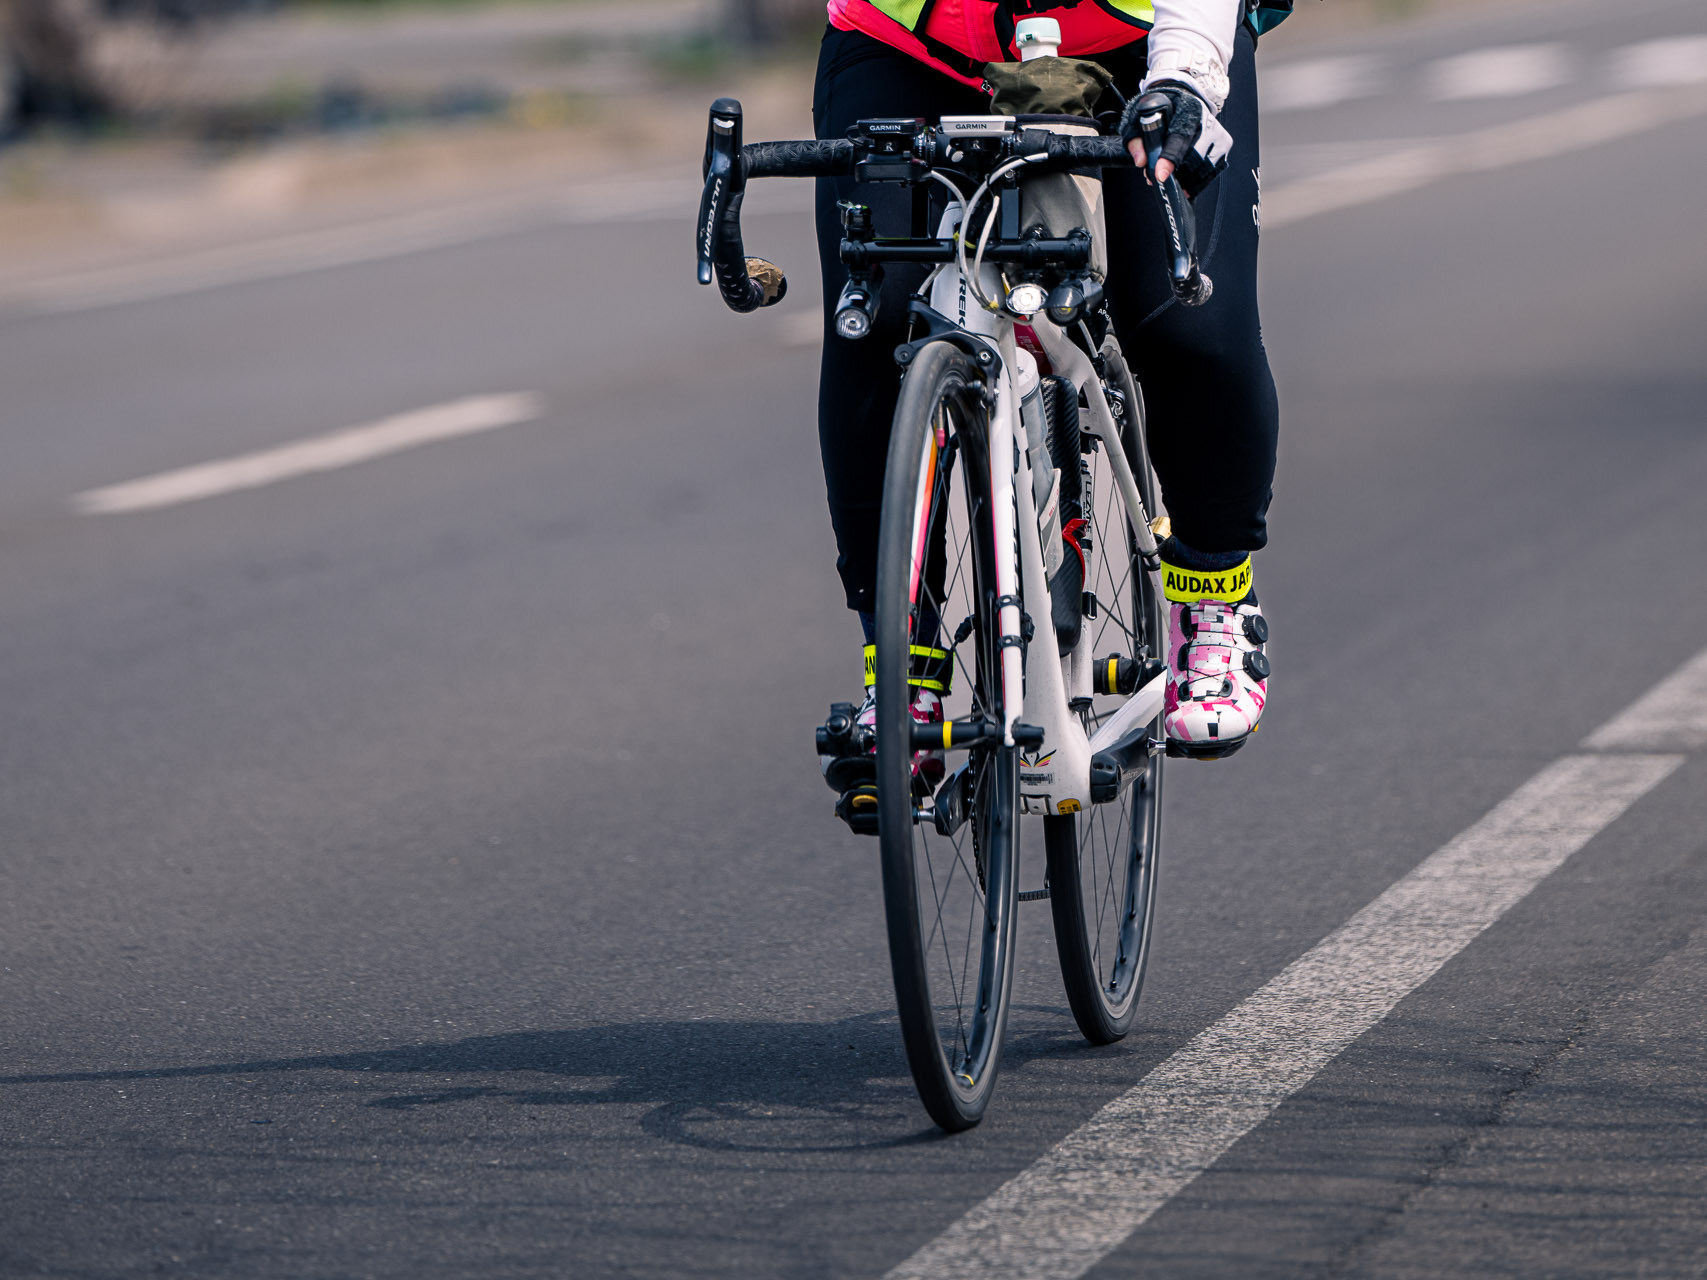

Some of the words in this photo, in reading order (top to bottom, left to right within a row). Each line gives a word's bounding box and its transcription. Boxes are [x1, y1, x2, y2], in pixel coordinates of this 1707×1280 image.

[704, 178, 722, 258] ULTEGRA
[959, 267, 967, 328] REK
[1166, 571, 1227, 593] AUDAX
